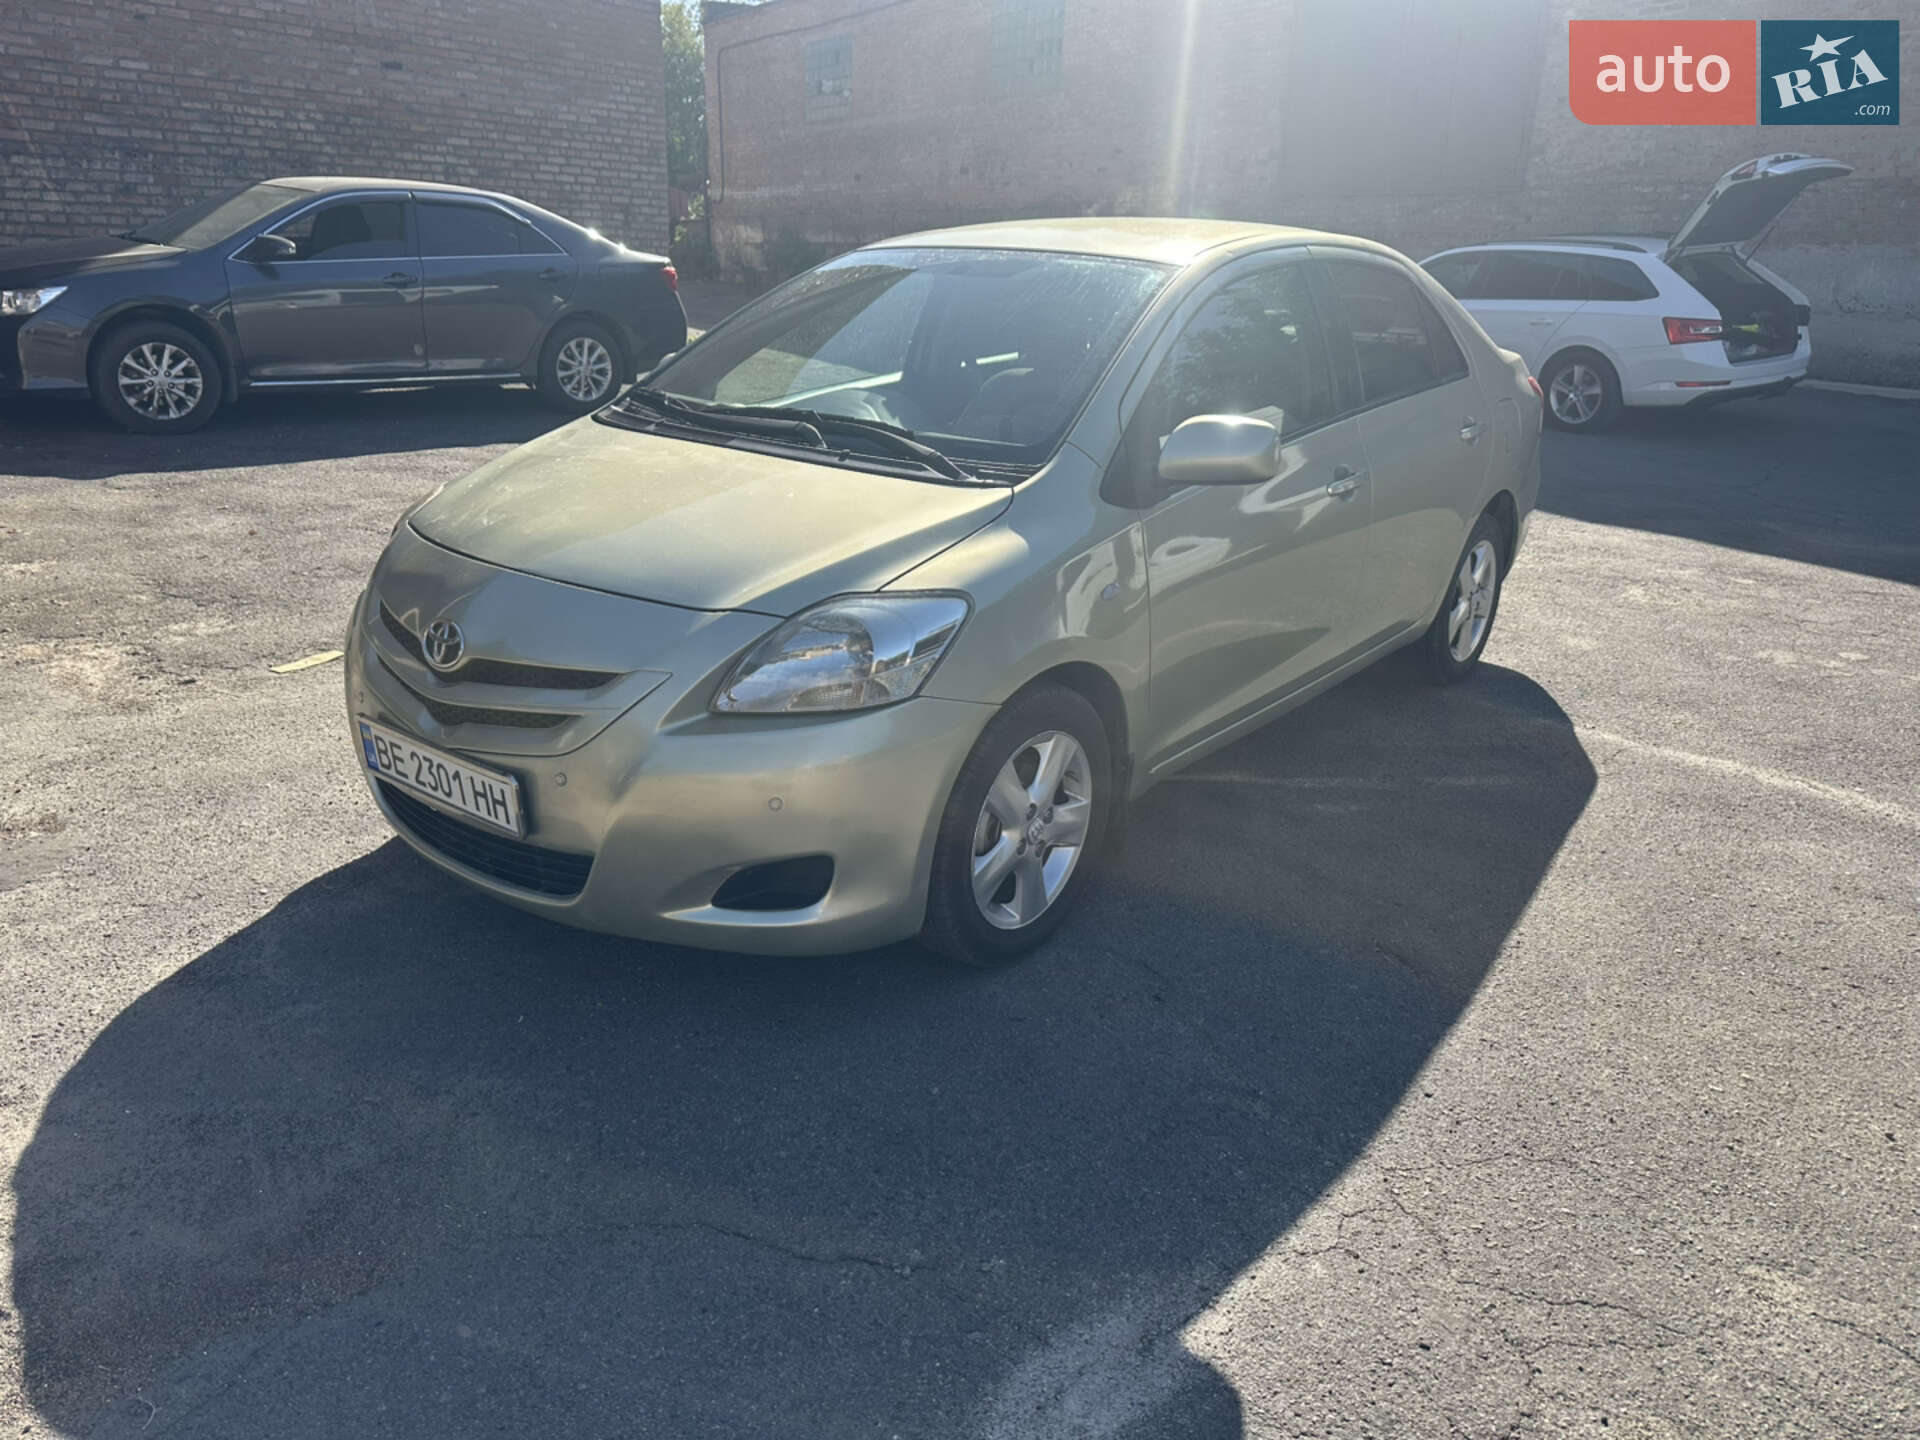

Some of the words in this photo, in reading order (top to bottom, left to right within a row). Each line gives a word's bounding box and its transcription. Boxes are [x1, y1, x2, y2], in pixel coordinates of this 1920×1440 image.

[374, 735, 409, 779] BE
[410, 751, 467, 805] 2301
[470, 776, 511, 825] HH
